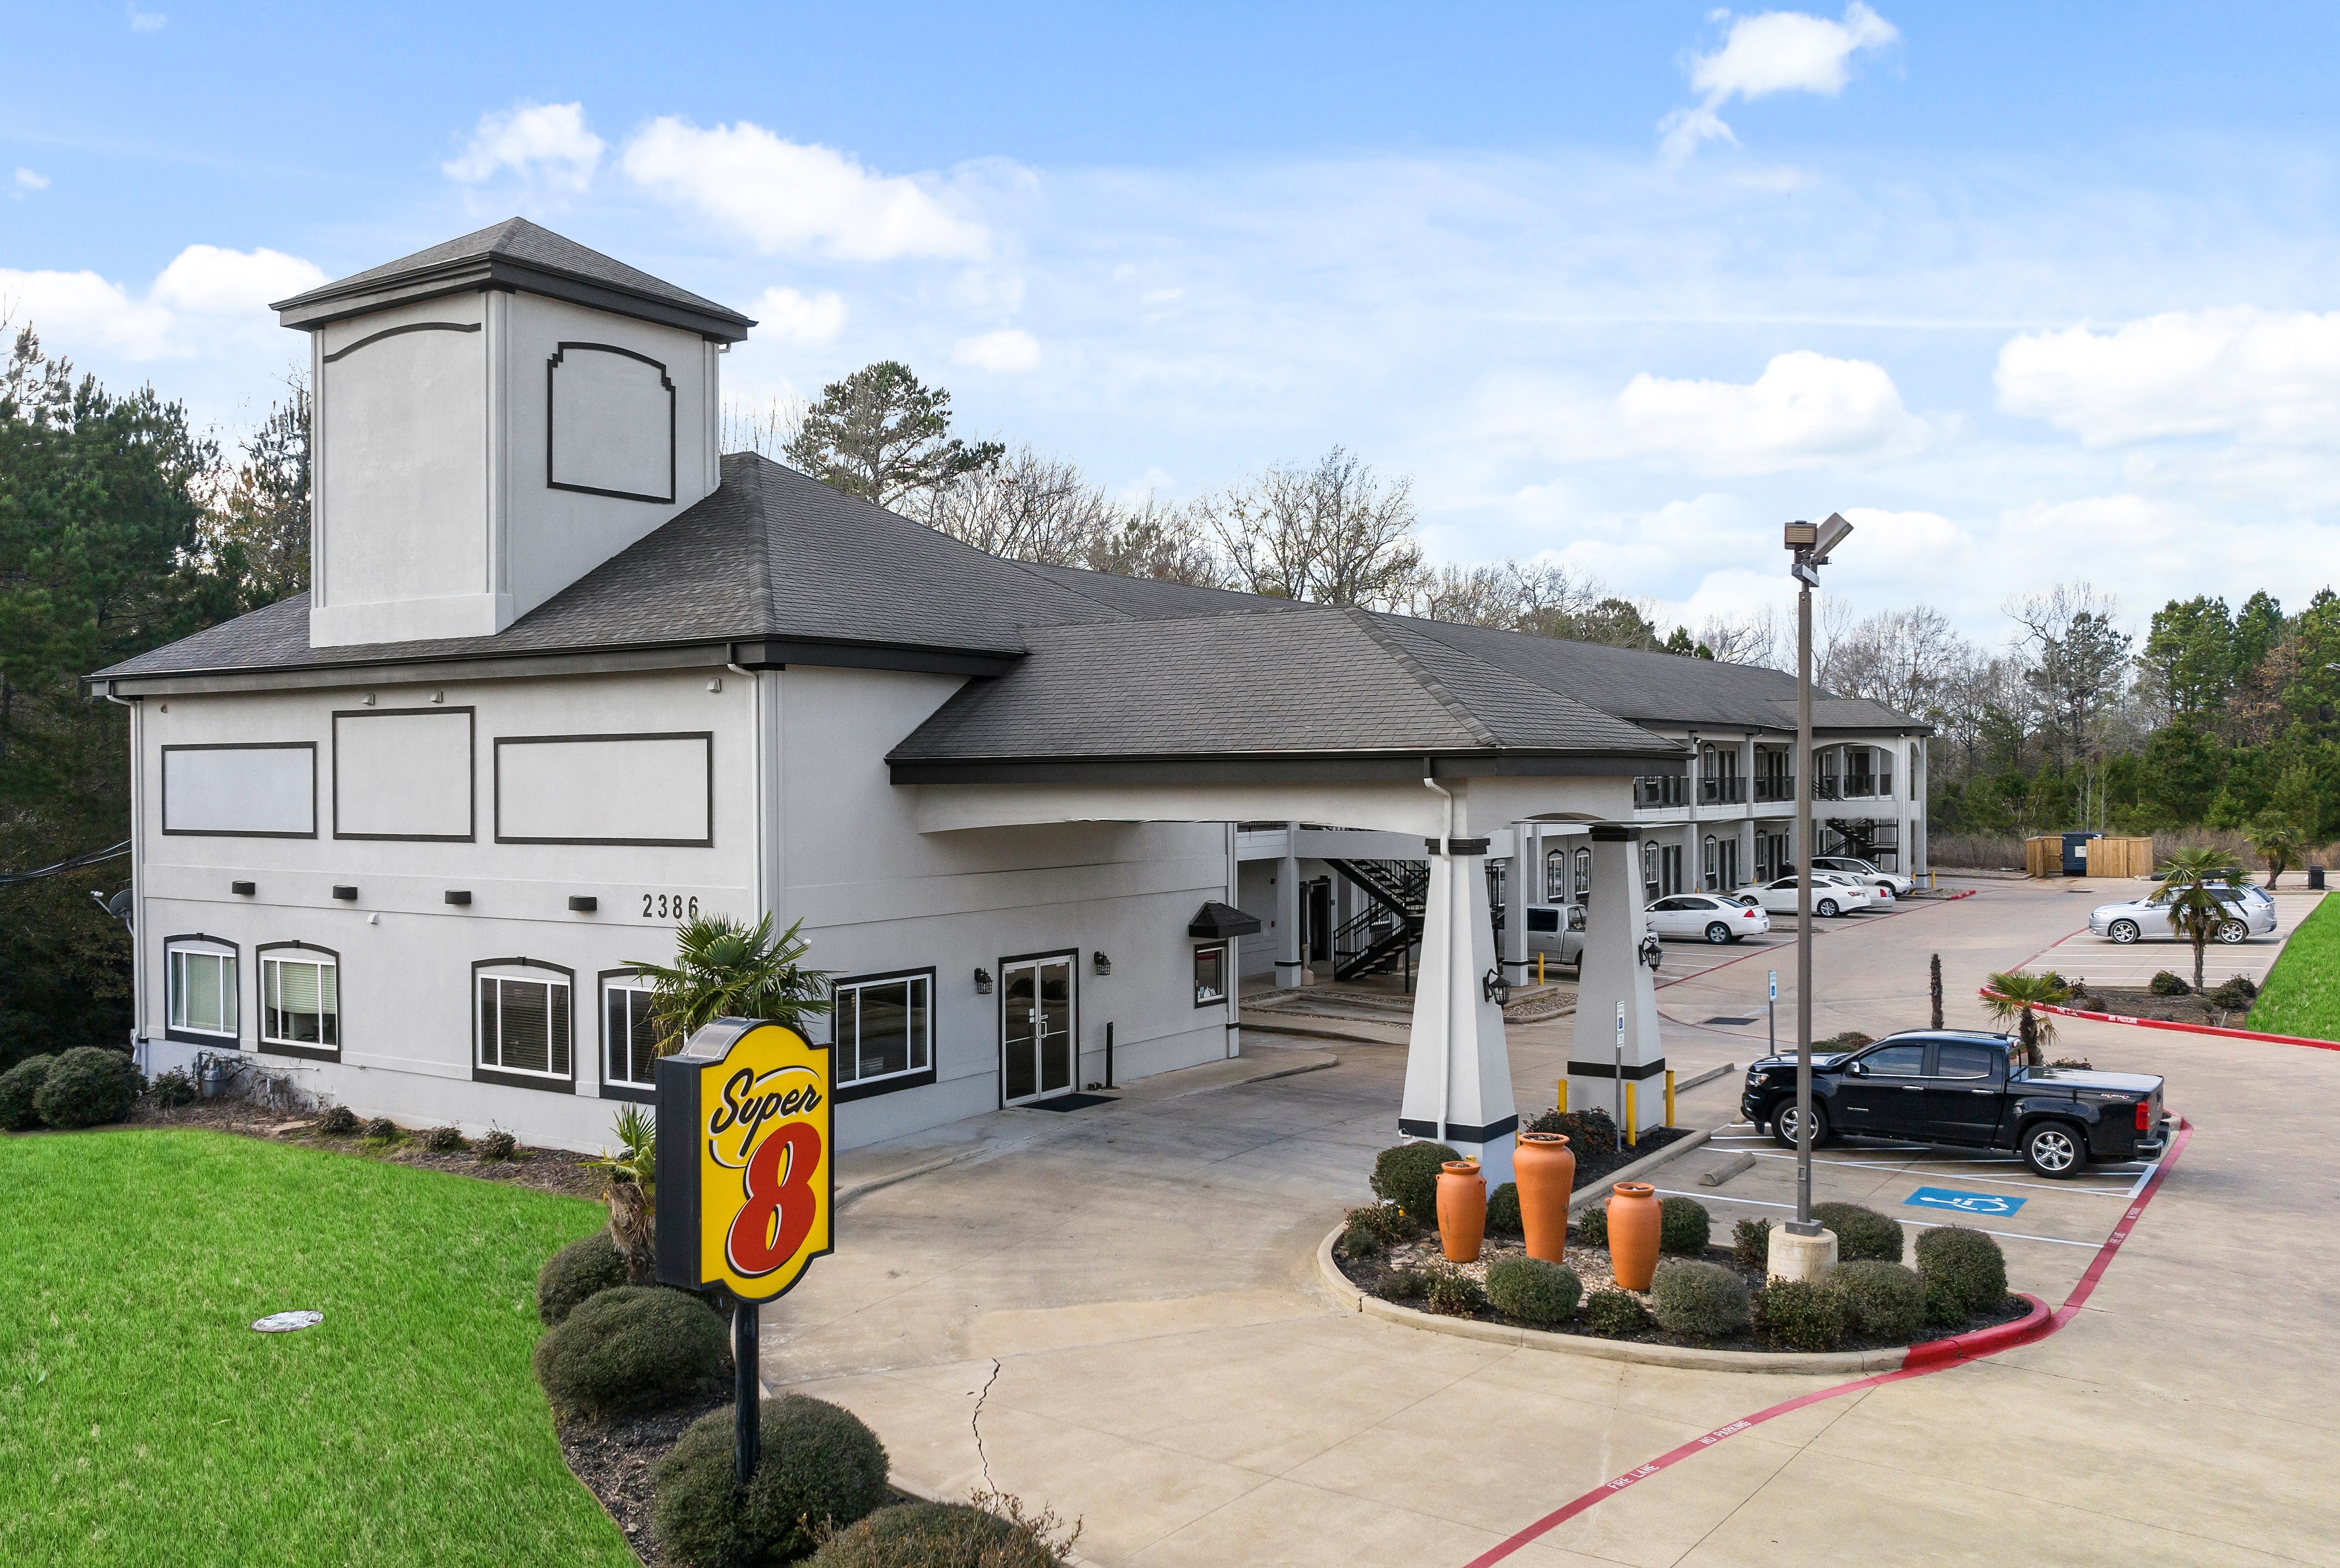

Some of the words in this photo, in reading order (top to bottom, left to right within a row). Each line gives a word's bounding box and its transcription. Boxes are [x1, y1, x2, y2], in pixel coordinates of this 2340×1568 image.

[643, 894, 698, 919] 2386
[708, 1068, 822, 1159] Super
[725, 1122, 821, 1278] 8
[1698, 1436, 1717, 1445] NO
[1713, 1420, 1752, 1438] PARKING
[1606, 1477, 1634, 1490] FIRE
[1629, 1464, 1660, 1478] LANE
